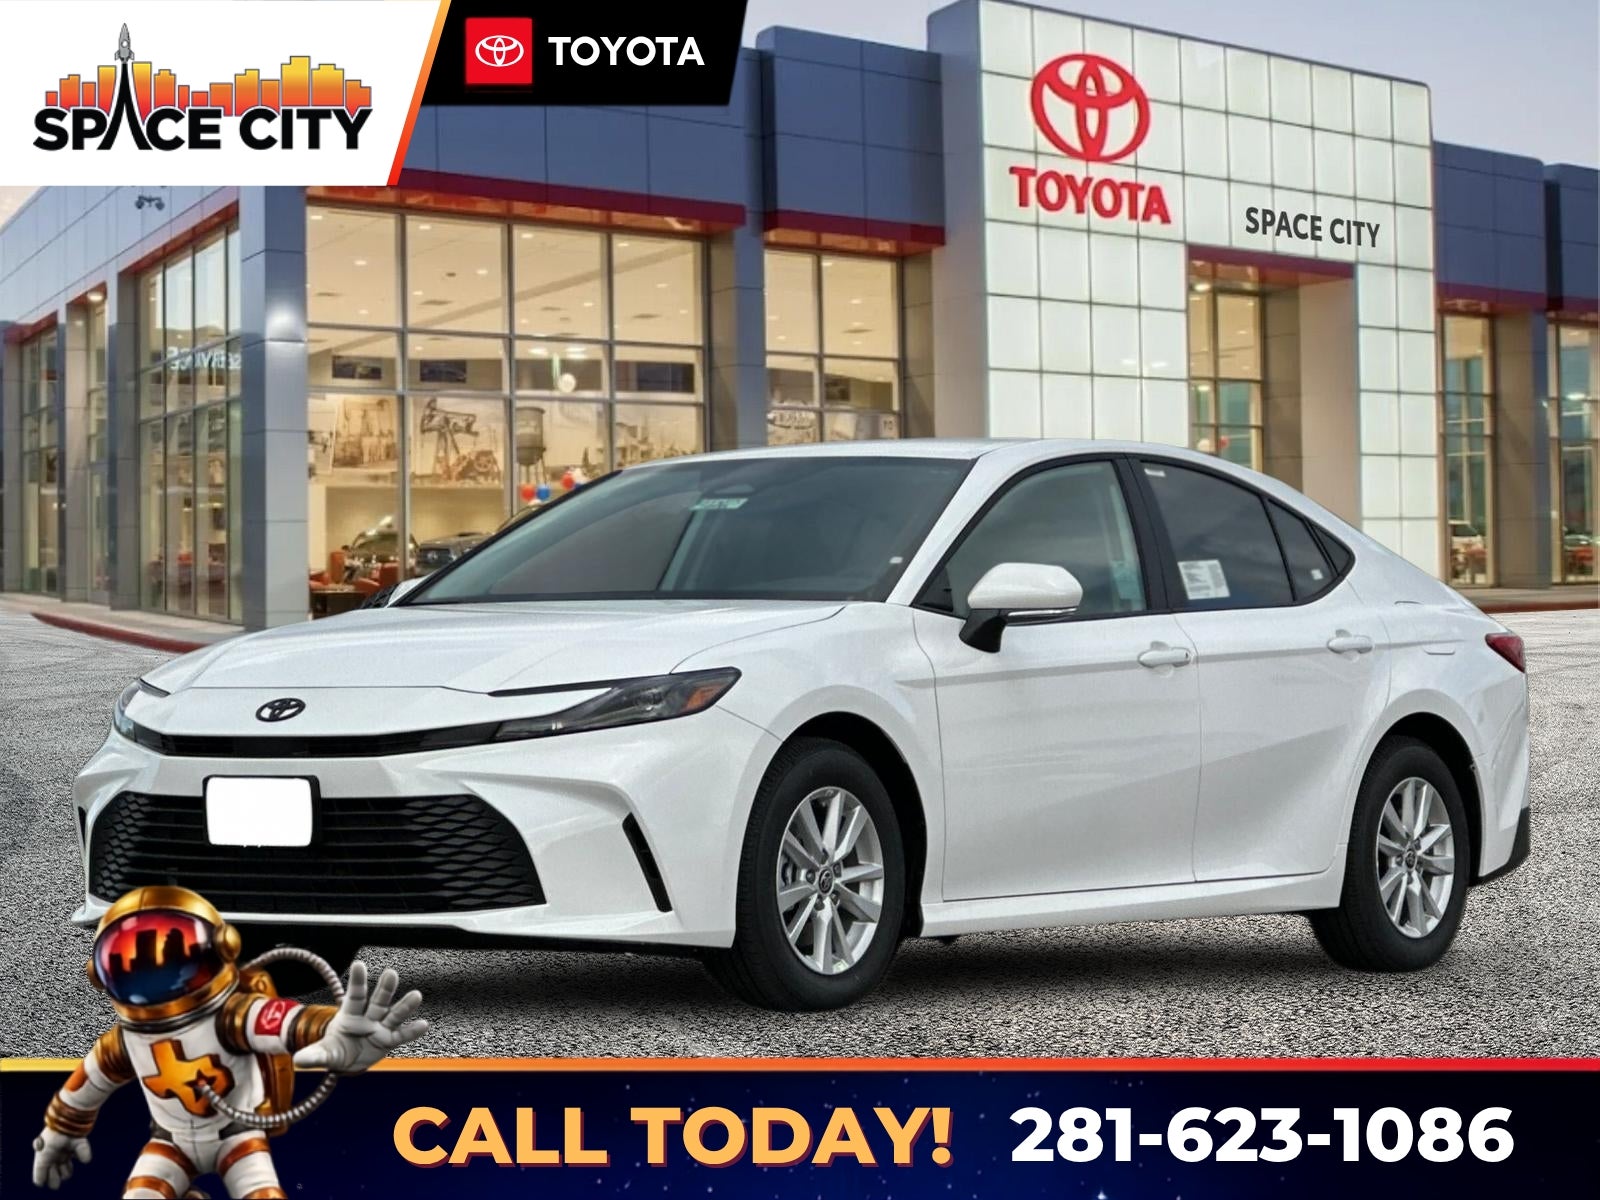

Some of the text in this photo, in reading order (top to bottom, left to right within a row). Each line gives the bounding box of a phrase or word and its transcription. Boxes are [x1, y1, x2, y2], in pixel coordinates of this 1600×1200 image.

[1009, 166, 1172, 225] TOYOTA
[1245, 206, 1380, 249] SPACE CITY
